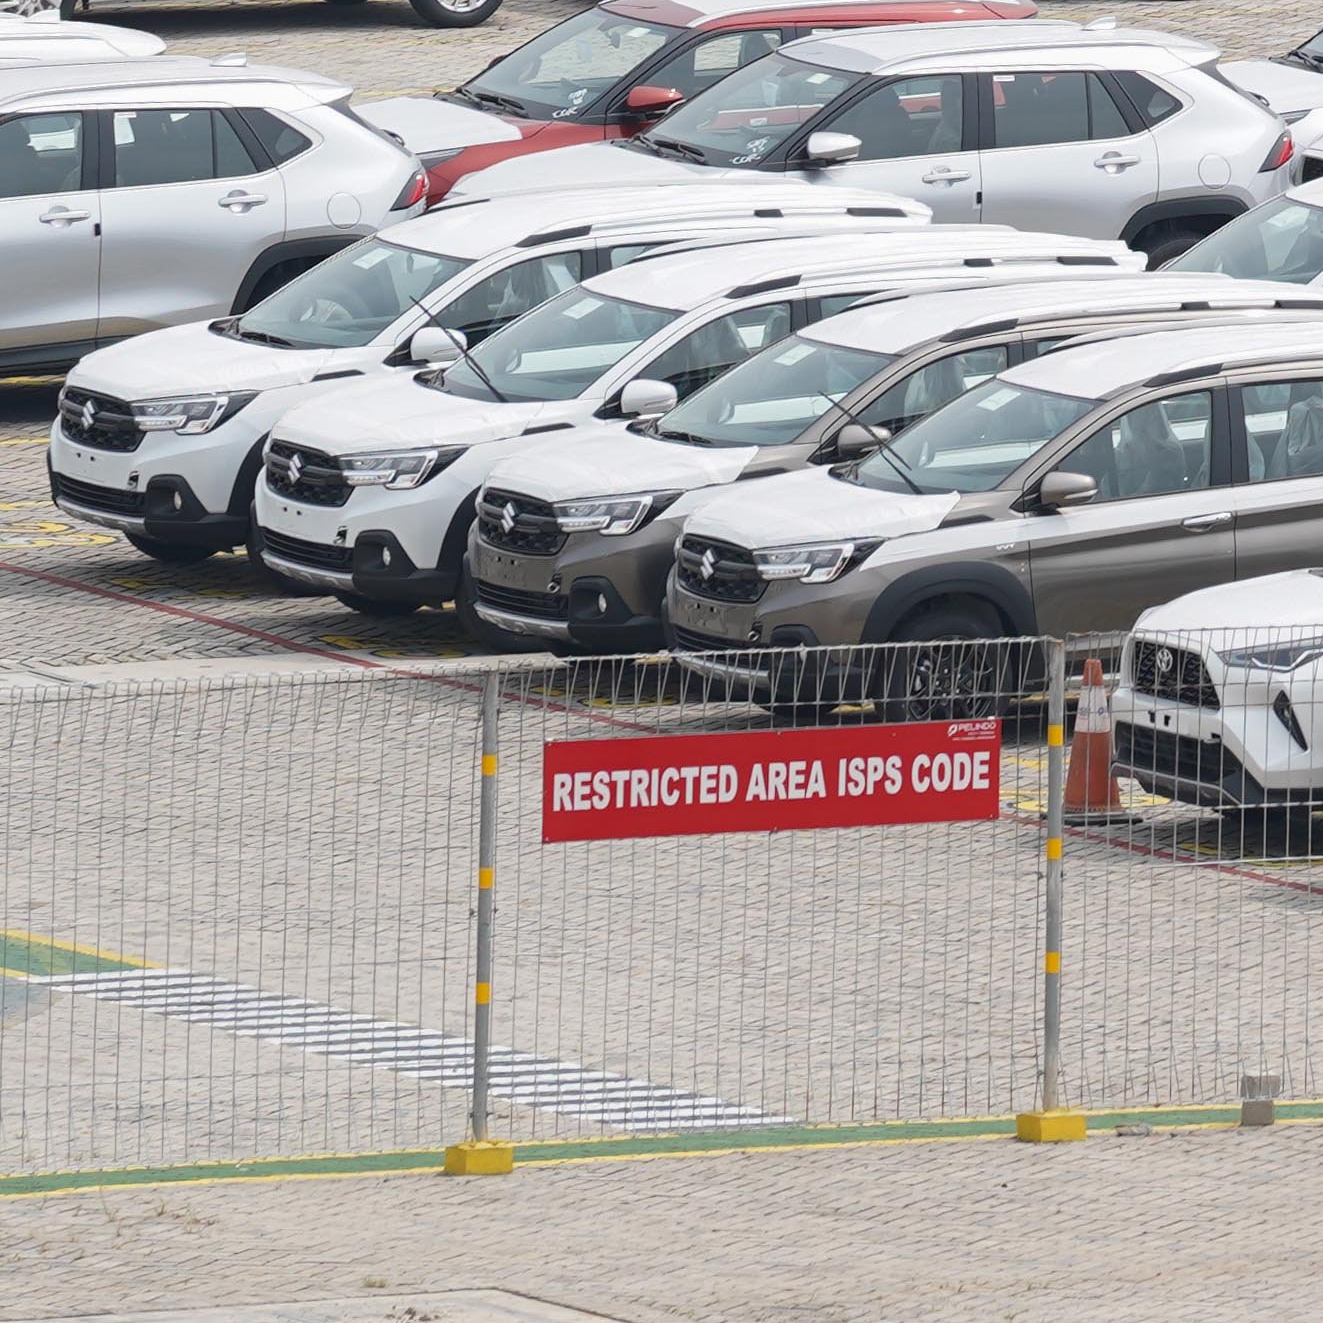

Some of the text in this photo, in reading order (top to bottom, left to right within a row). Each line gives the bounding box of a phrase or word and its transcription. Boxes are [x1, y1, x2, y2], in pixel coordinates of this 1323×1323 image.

[552, 750, 991, 813] RESTRICTED AREA ISPS CODE
